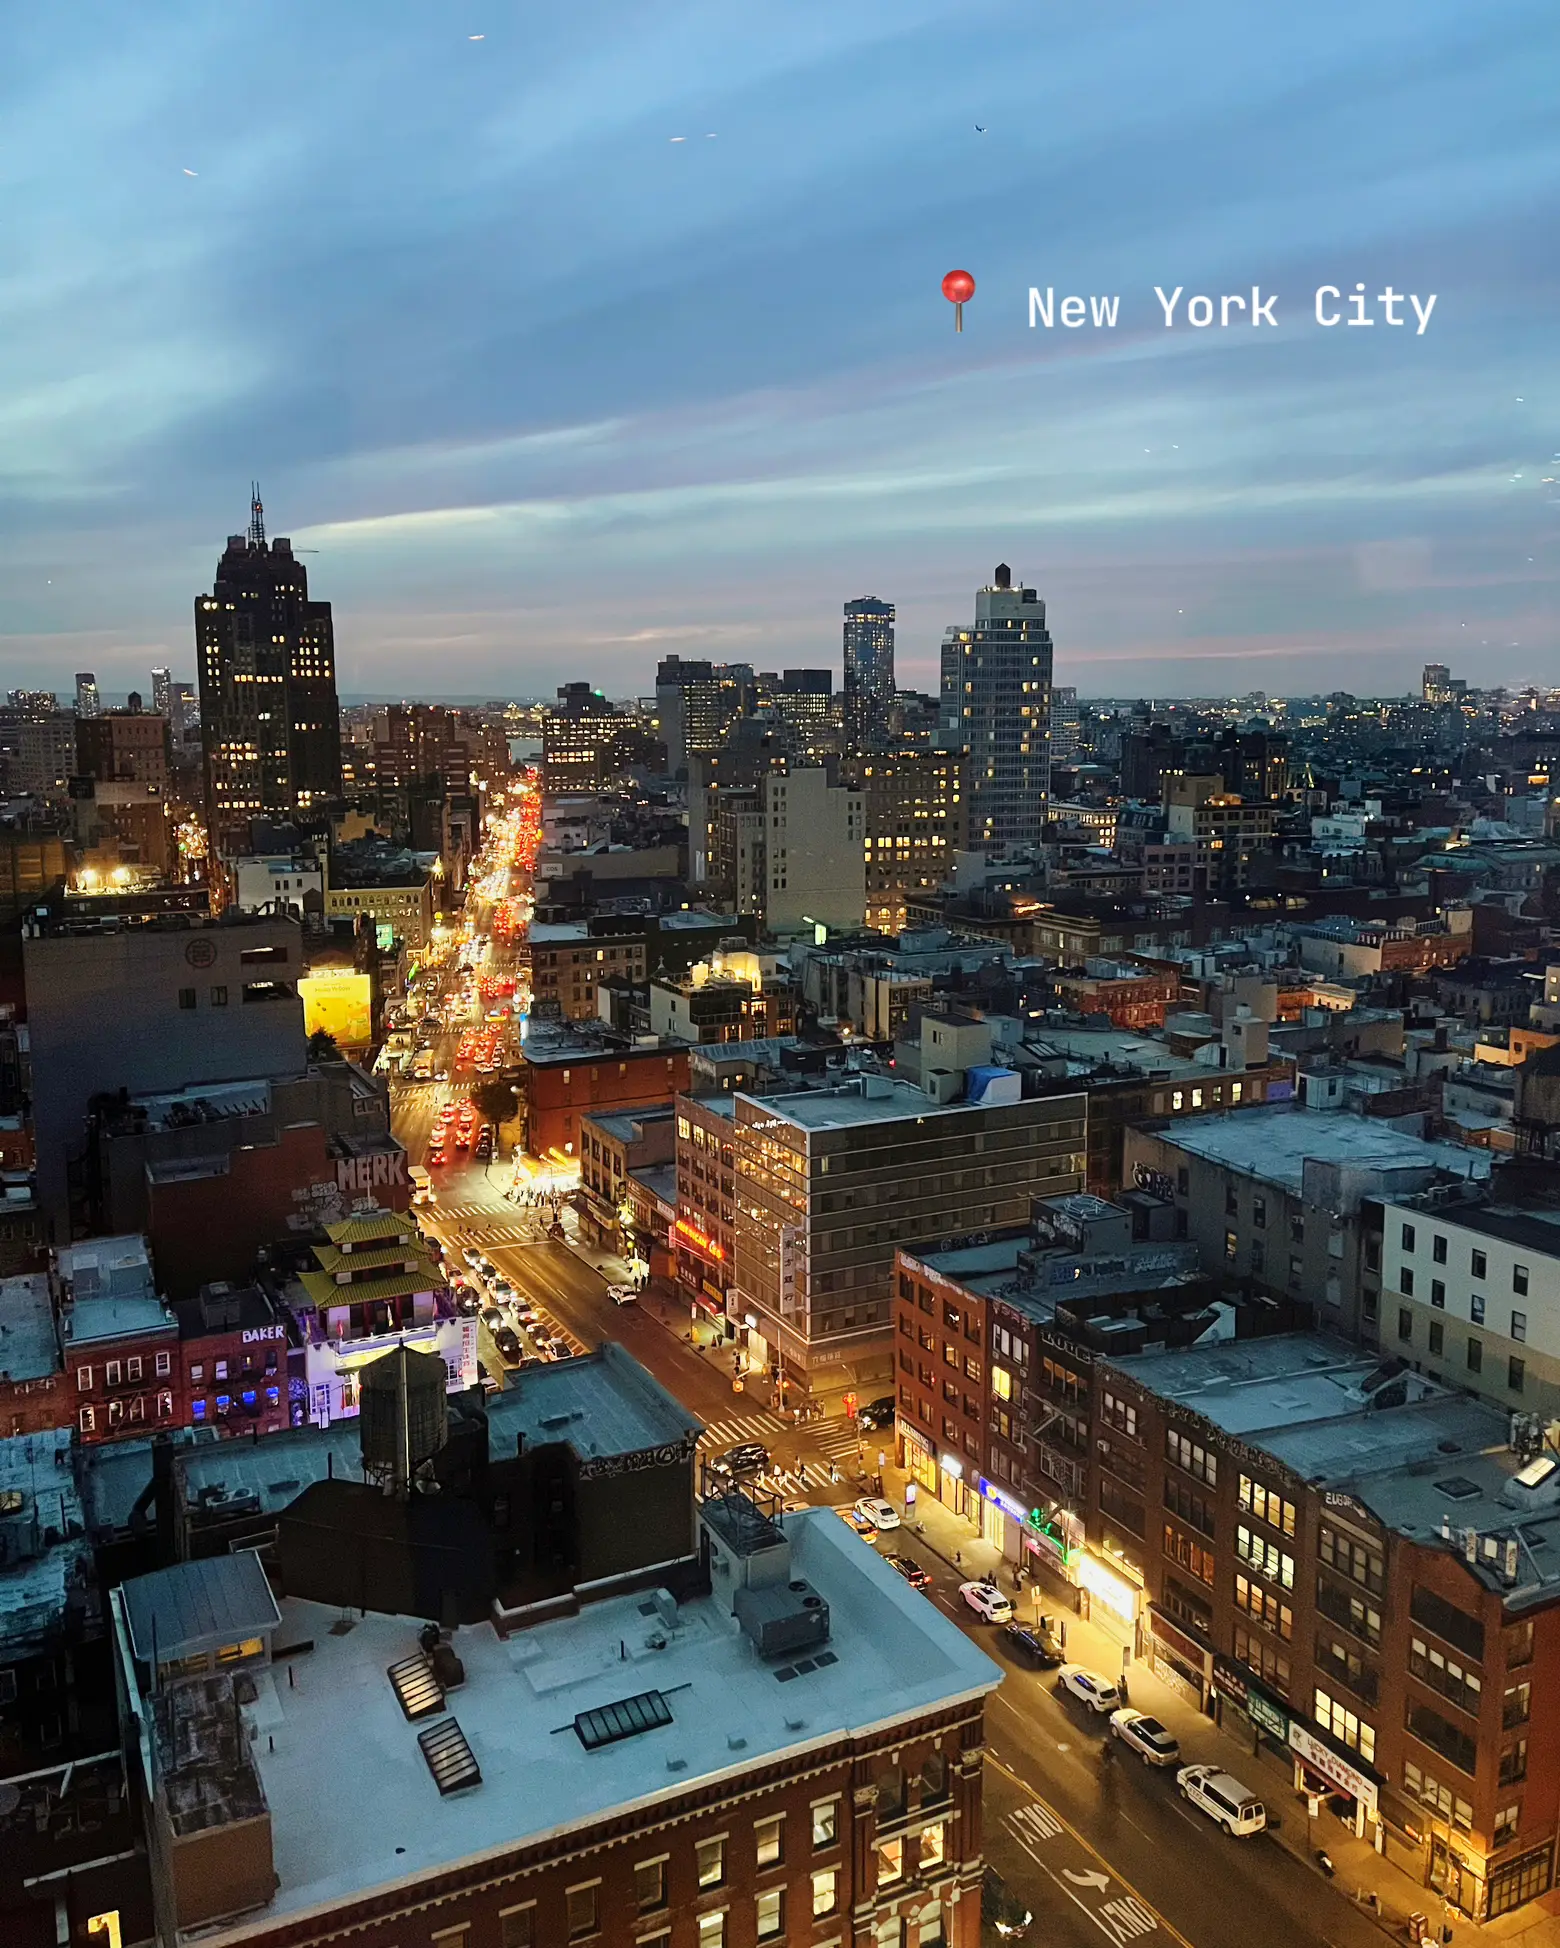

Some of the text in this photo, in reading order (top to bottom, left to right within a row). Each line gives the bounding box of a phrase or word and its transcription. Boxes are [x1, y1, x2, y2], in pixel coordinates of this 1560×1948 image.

[337, 1151, 406, 1191] MERK
[242, 1325, 285, 1343] BAKER
[1331, 1756, 1363, 1786] DIAMOND
[1007, 1803, 1065, 1845] ONLY
[1098, 1896, 1159, 1943] ONLY
